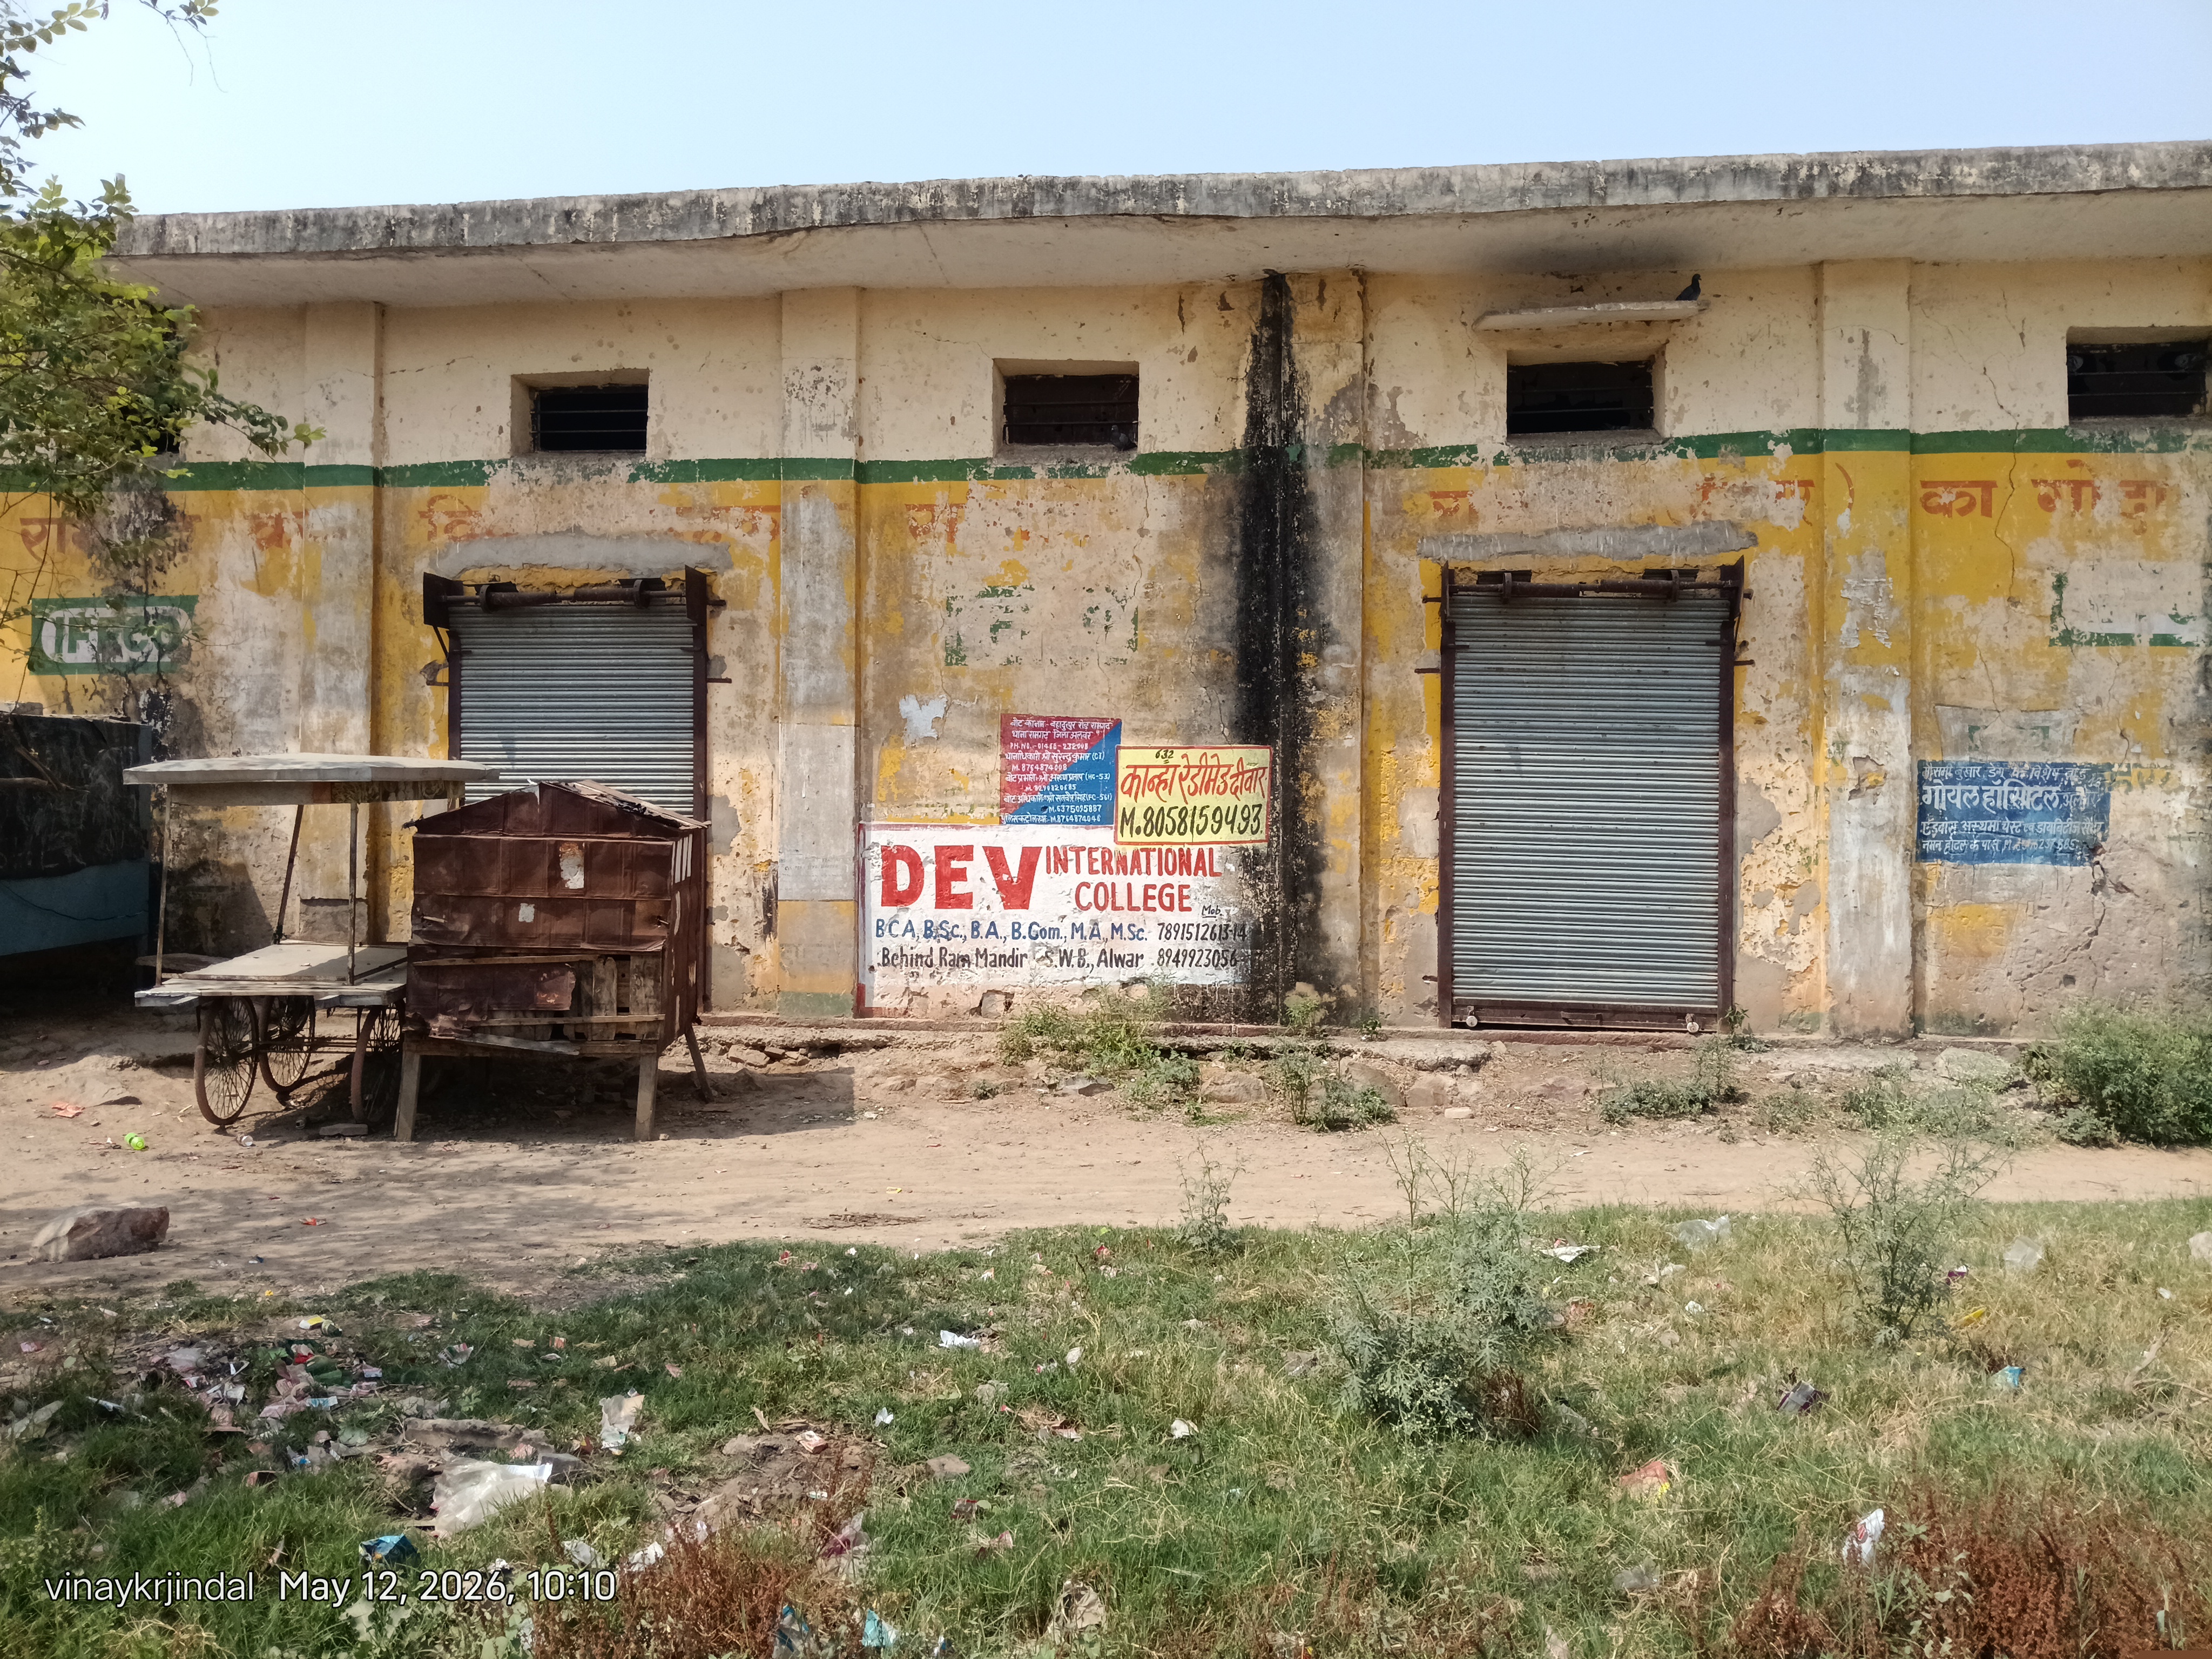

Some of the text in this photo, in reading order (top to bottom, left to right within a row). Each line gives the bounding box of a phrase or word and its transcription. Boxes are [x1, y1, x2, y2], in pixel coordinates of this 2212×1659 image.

[1920, 480, 1998, 518] का
[1011, 730, 1028, 738] थाना
[1052, 729, 1070, 739] जिला
[1070, 731, 1093, 740] अलवर
[1078, 719, 1089, 730] रोड
[1072, 752, 1091, 763] कुमार
[1155, 749, 1175, 759] 632
[1121, 752, 1269, 805] कान्हा रेडीमेड दीवार
[1921, 779, 1980, 811] गोयल
[1922, 839, 1944, 853] नमन
[1944, 837, 1968, 854] होटल
[881, 845, 1223, 911] DEV INTERNATIONAL
[1075, 881, 1192, 912] COLLEGE
[882, 946, 934, 968] Behind
[939, 946, 971, 968] Ram
[975, 947, 1028, 968] Mandir
[1096, 948, 1144, 968] Alwar
